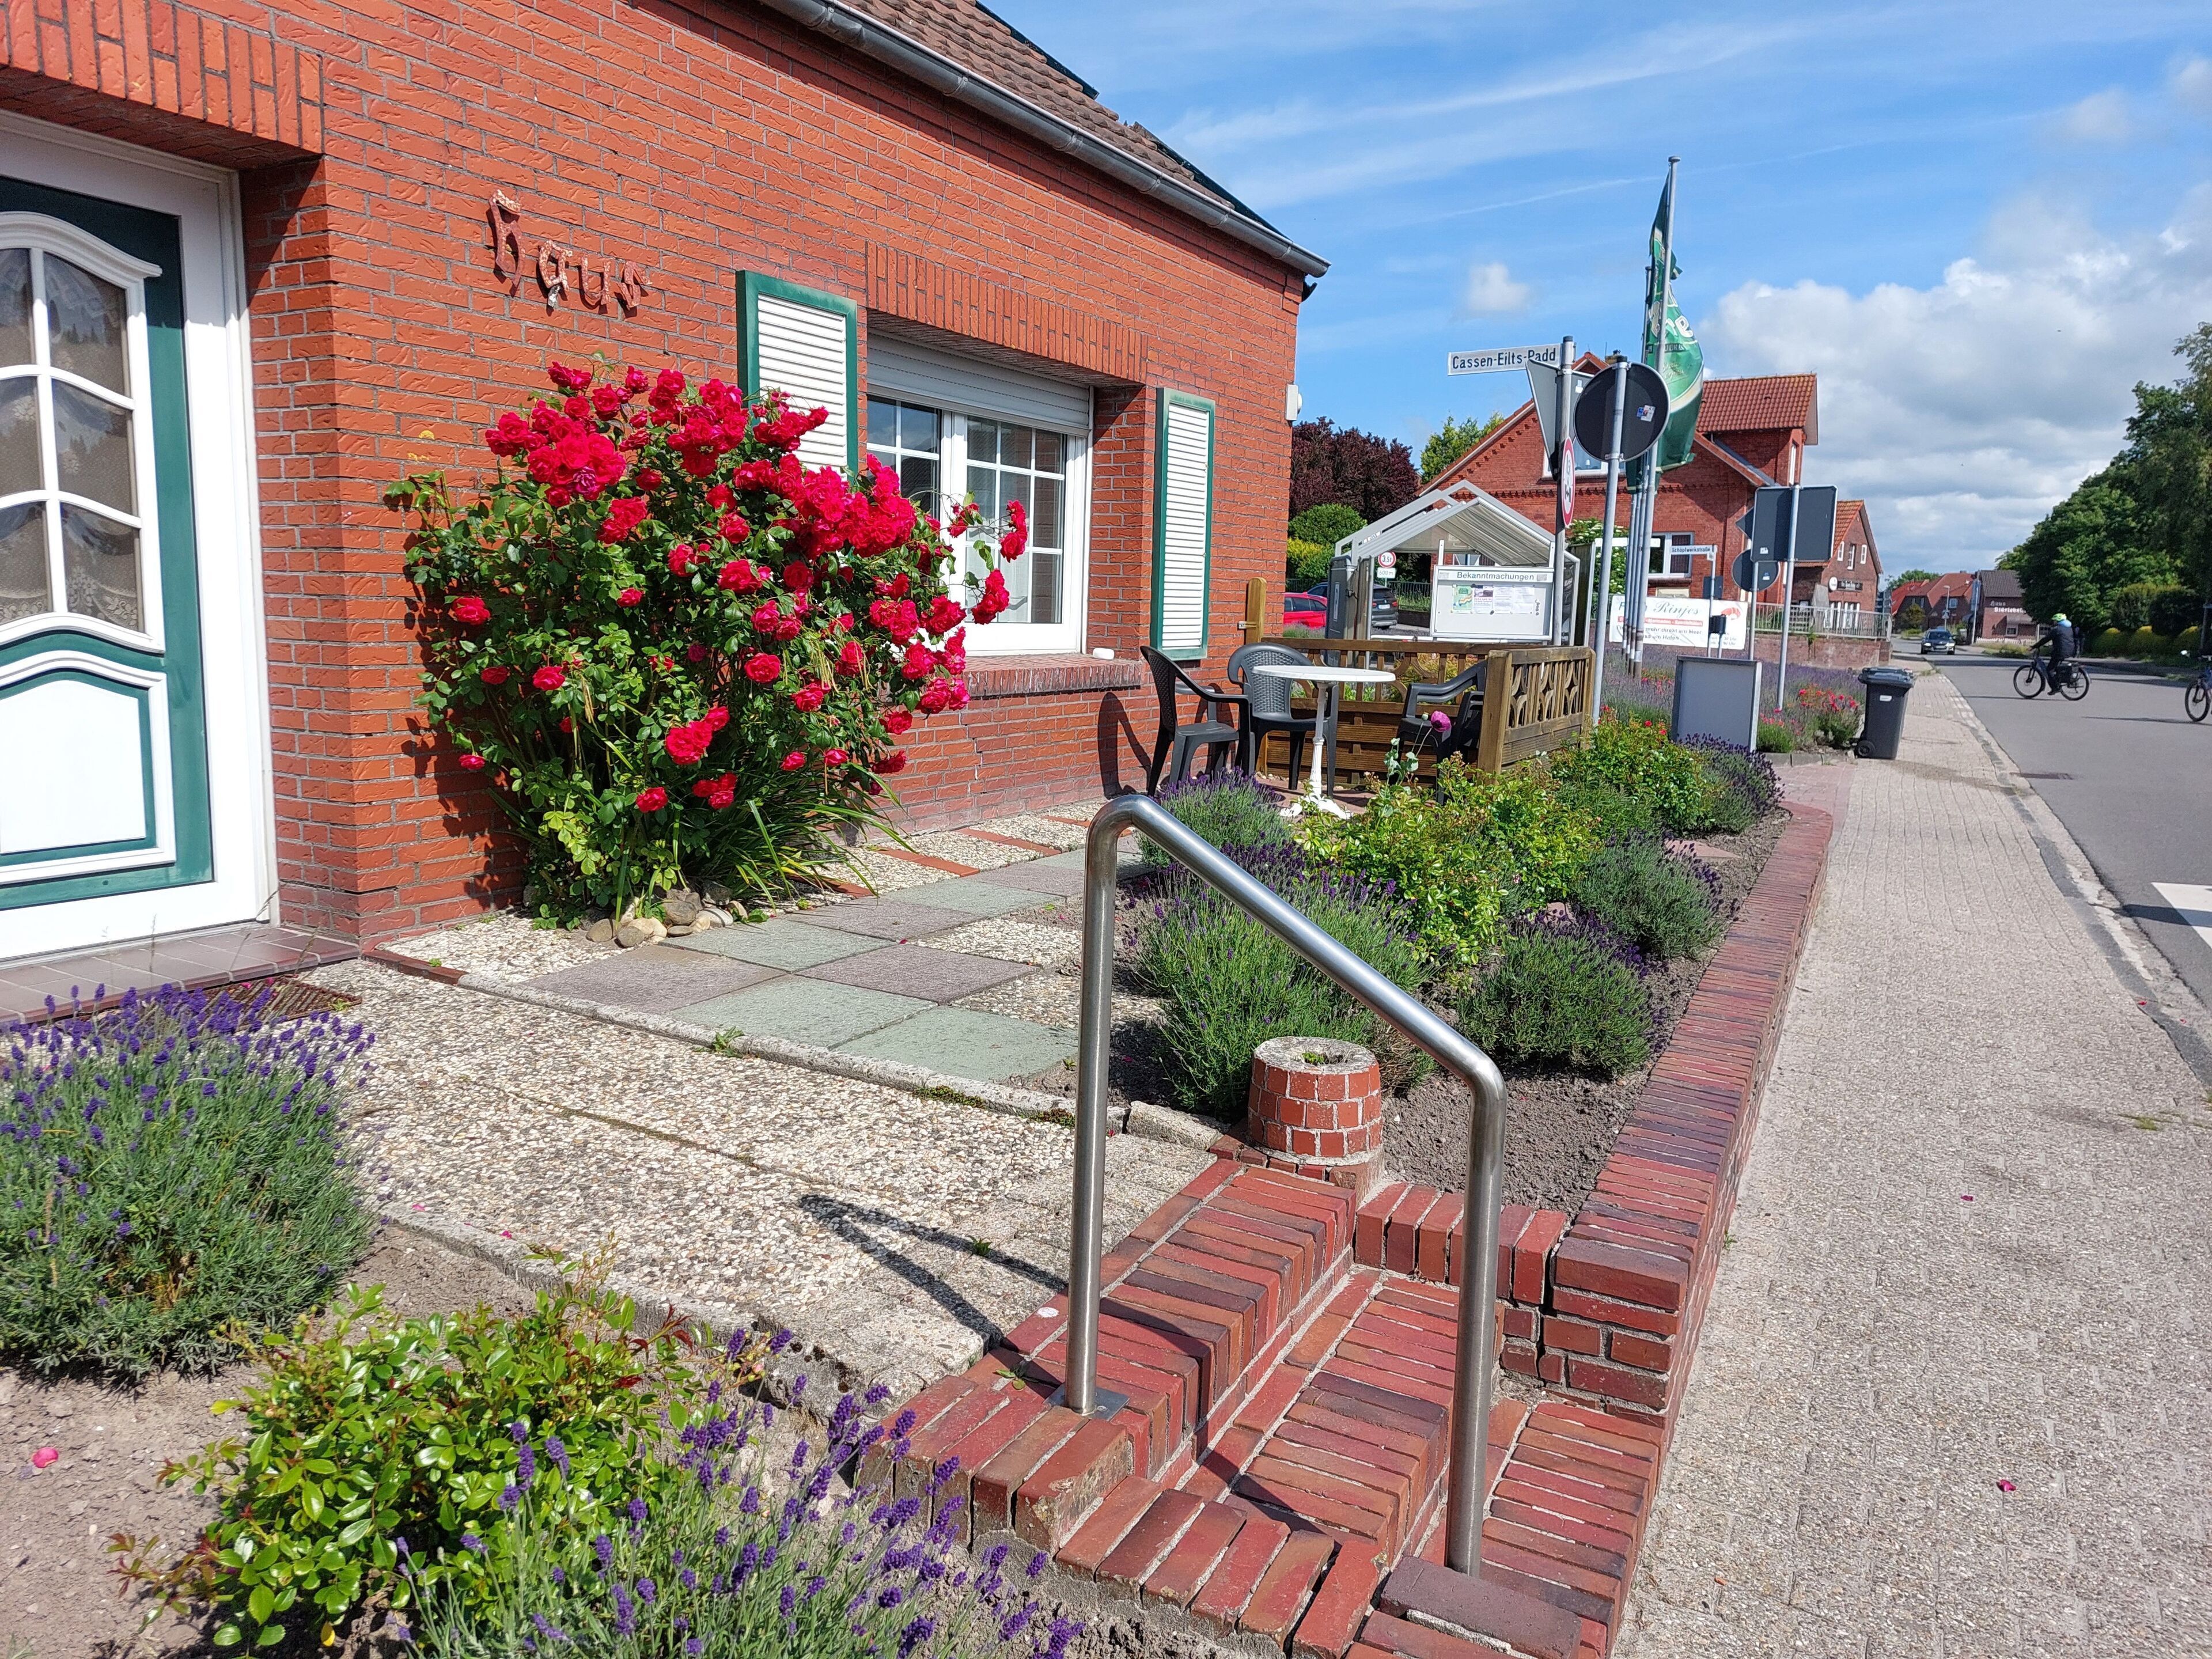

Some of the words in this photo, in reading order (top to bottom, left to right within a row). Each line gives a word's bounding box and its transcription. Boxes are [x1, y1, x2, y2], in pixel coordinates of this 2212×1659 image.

[1452, 347, 1556, 369] Cassen-Eilts-Padd
[1457, 571, 1535, 581] Bekanntmachungen
[1653, 601, 1699, 618] Rinjes
